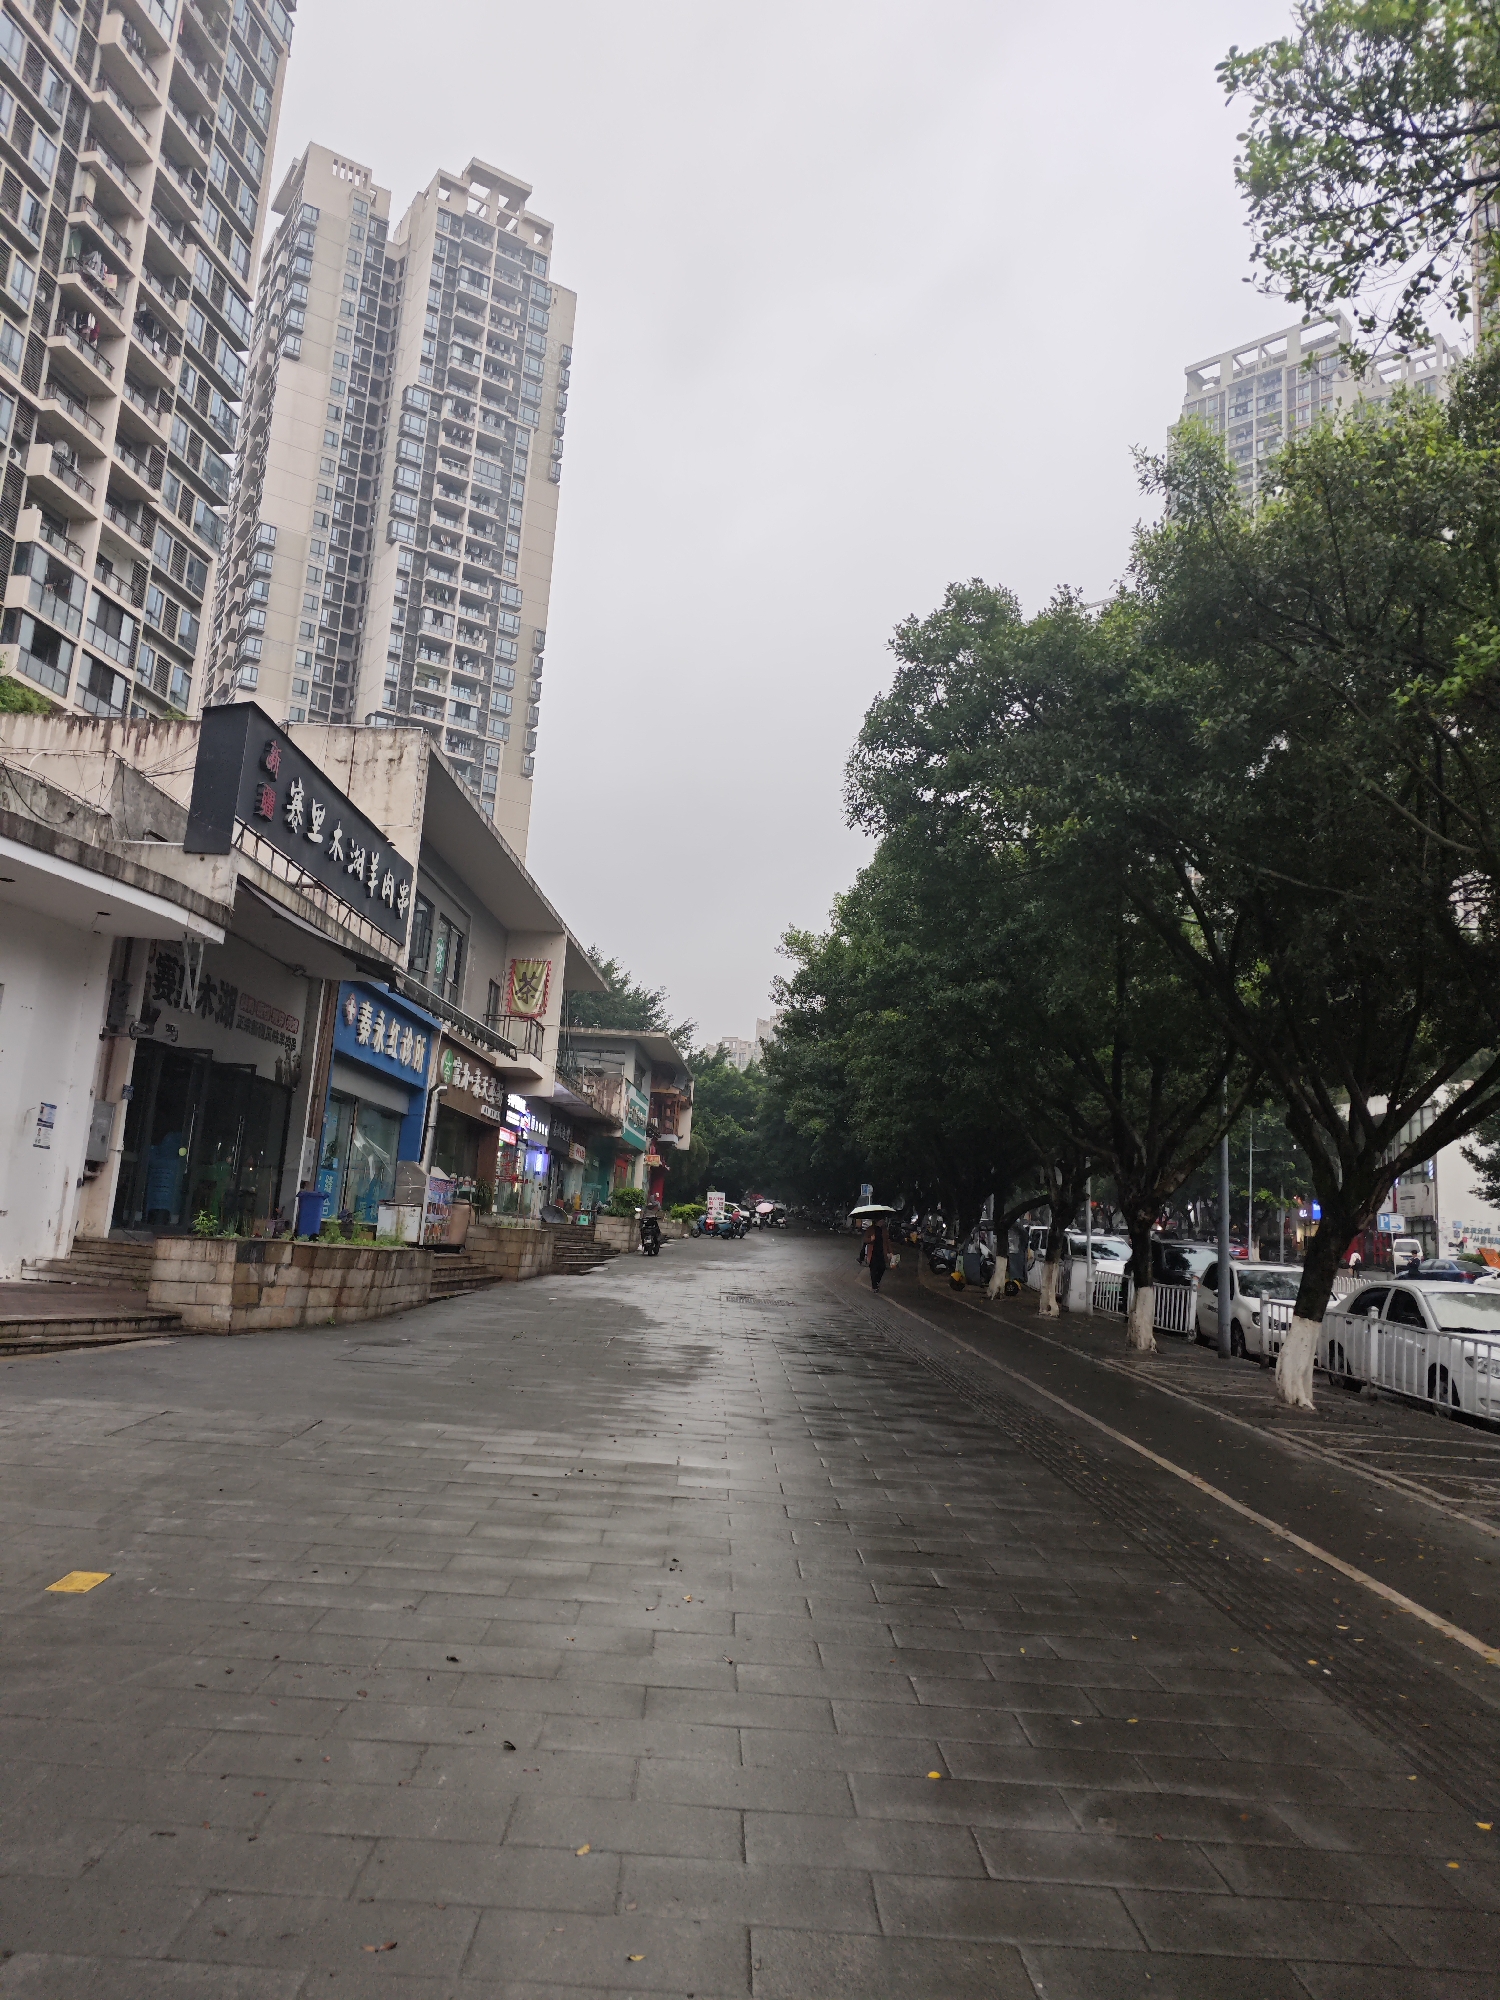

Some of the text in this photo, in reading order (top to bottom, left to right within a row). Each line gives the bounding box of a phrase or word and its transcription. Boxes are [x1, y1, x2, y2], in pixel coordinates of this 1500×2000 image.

[261, 740, 283, 821] 新疆
[286, 777, 410, 919] 赛里木湖羊肉串
[515, 971, 543, 1004] 茶
[1379, 1215, 1389, 1228] P
